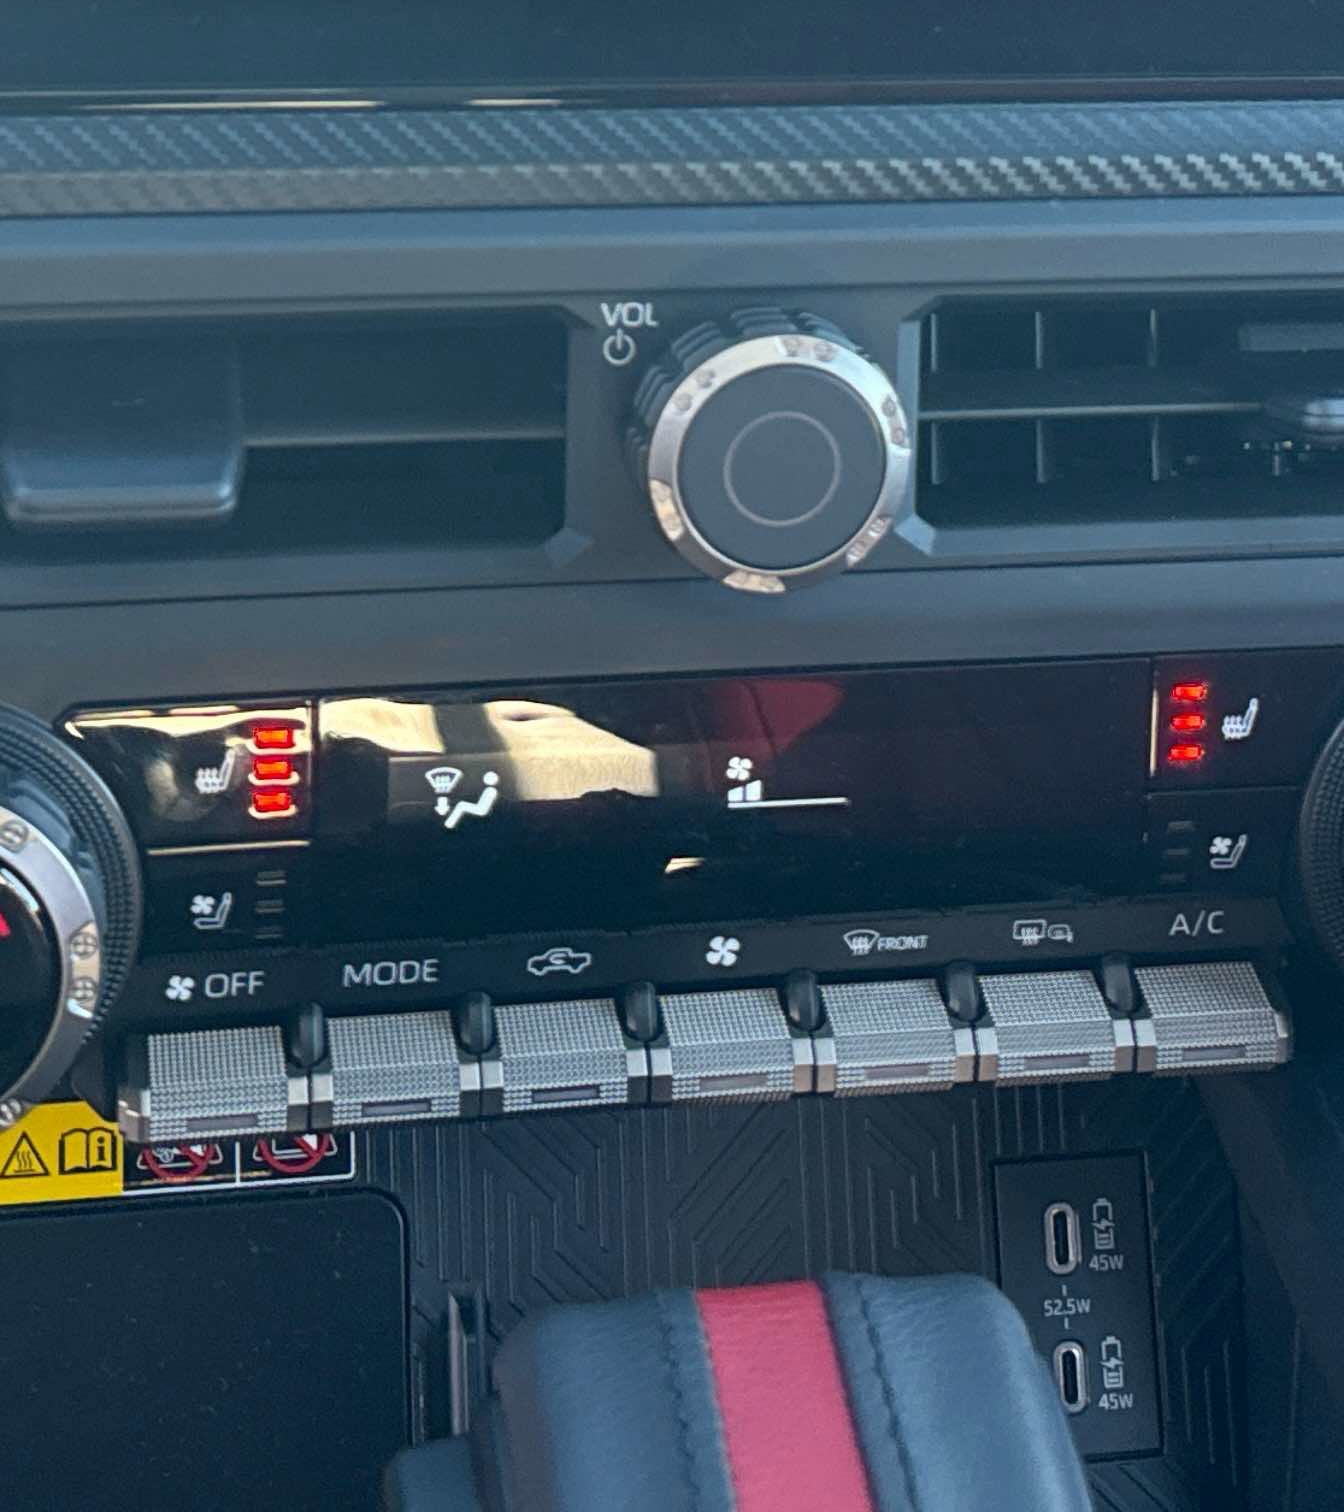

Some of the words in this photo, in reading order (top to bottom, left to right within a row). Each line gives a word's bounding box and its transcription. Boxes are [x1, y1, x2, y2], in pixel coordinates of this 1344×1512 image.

[600, 302, 659, 327] VOL
[1169, 909, 1226, 937] A/C
[876, 933, 929, 952] FRONT
[204, 970, 265, 998] OFF
[343, 958, 440, 989] MODE
[1088, 1253, 1124, 1271] 45W
[1043, 1298, 1092, 1317] 52.5W
[1098, 1392, 1134, 1410] 45W
